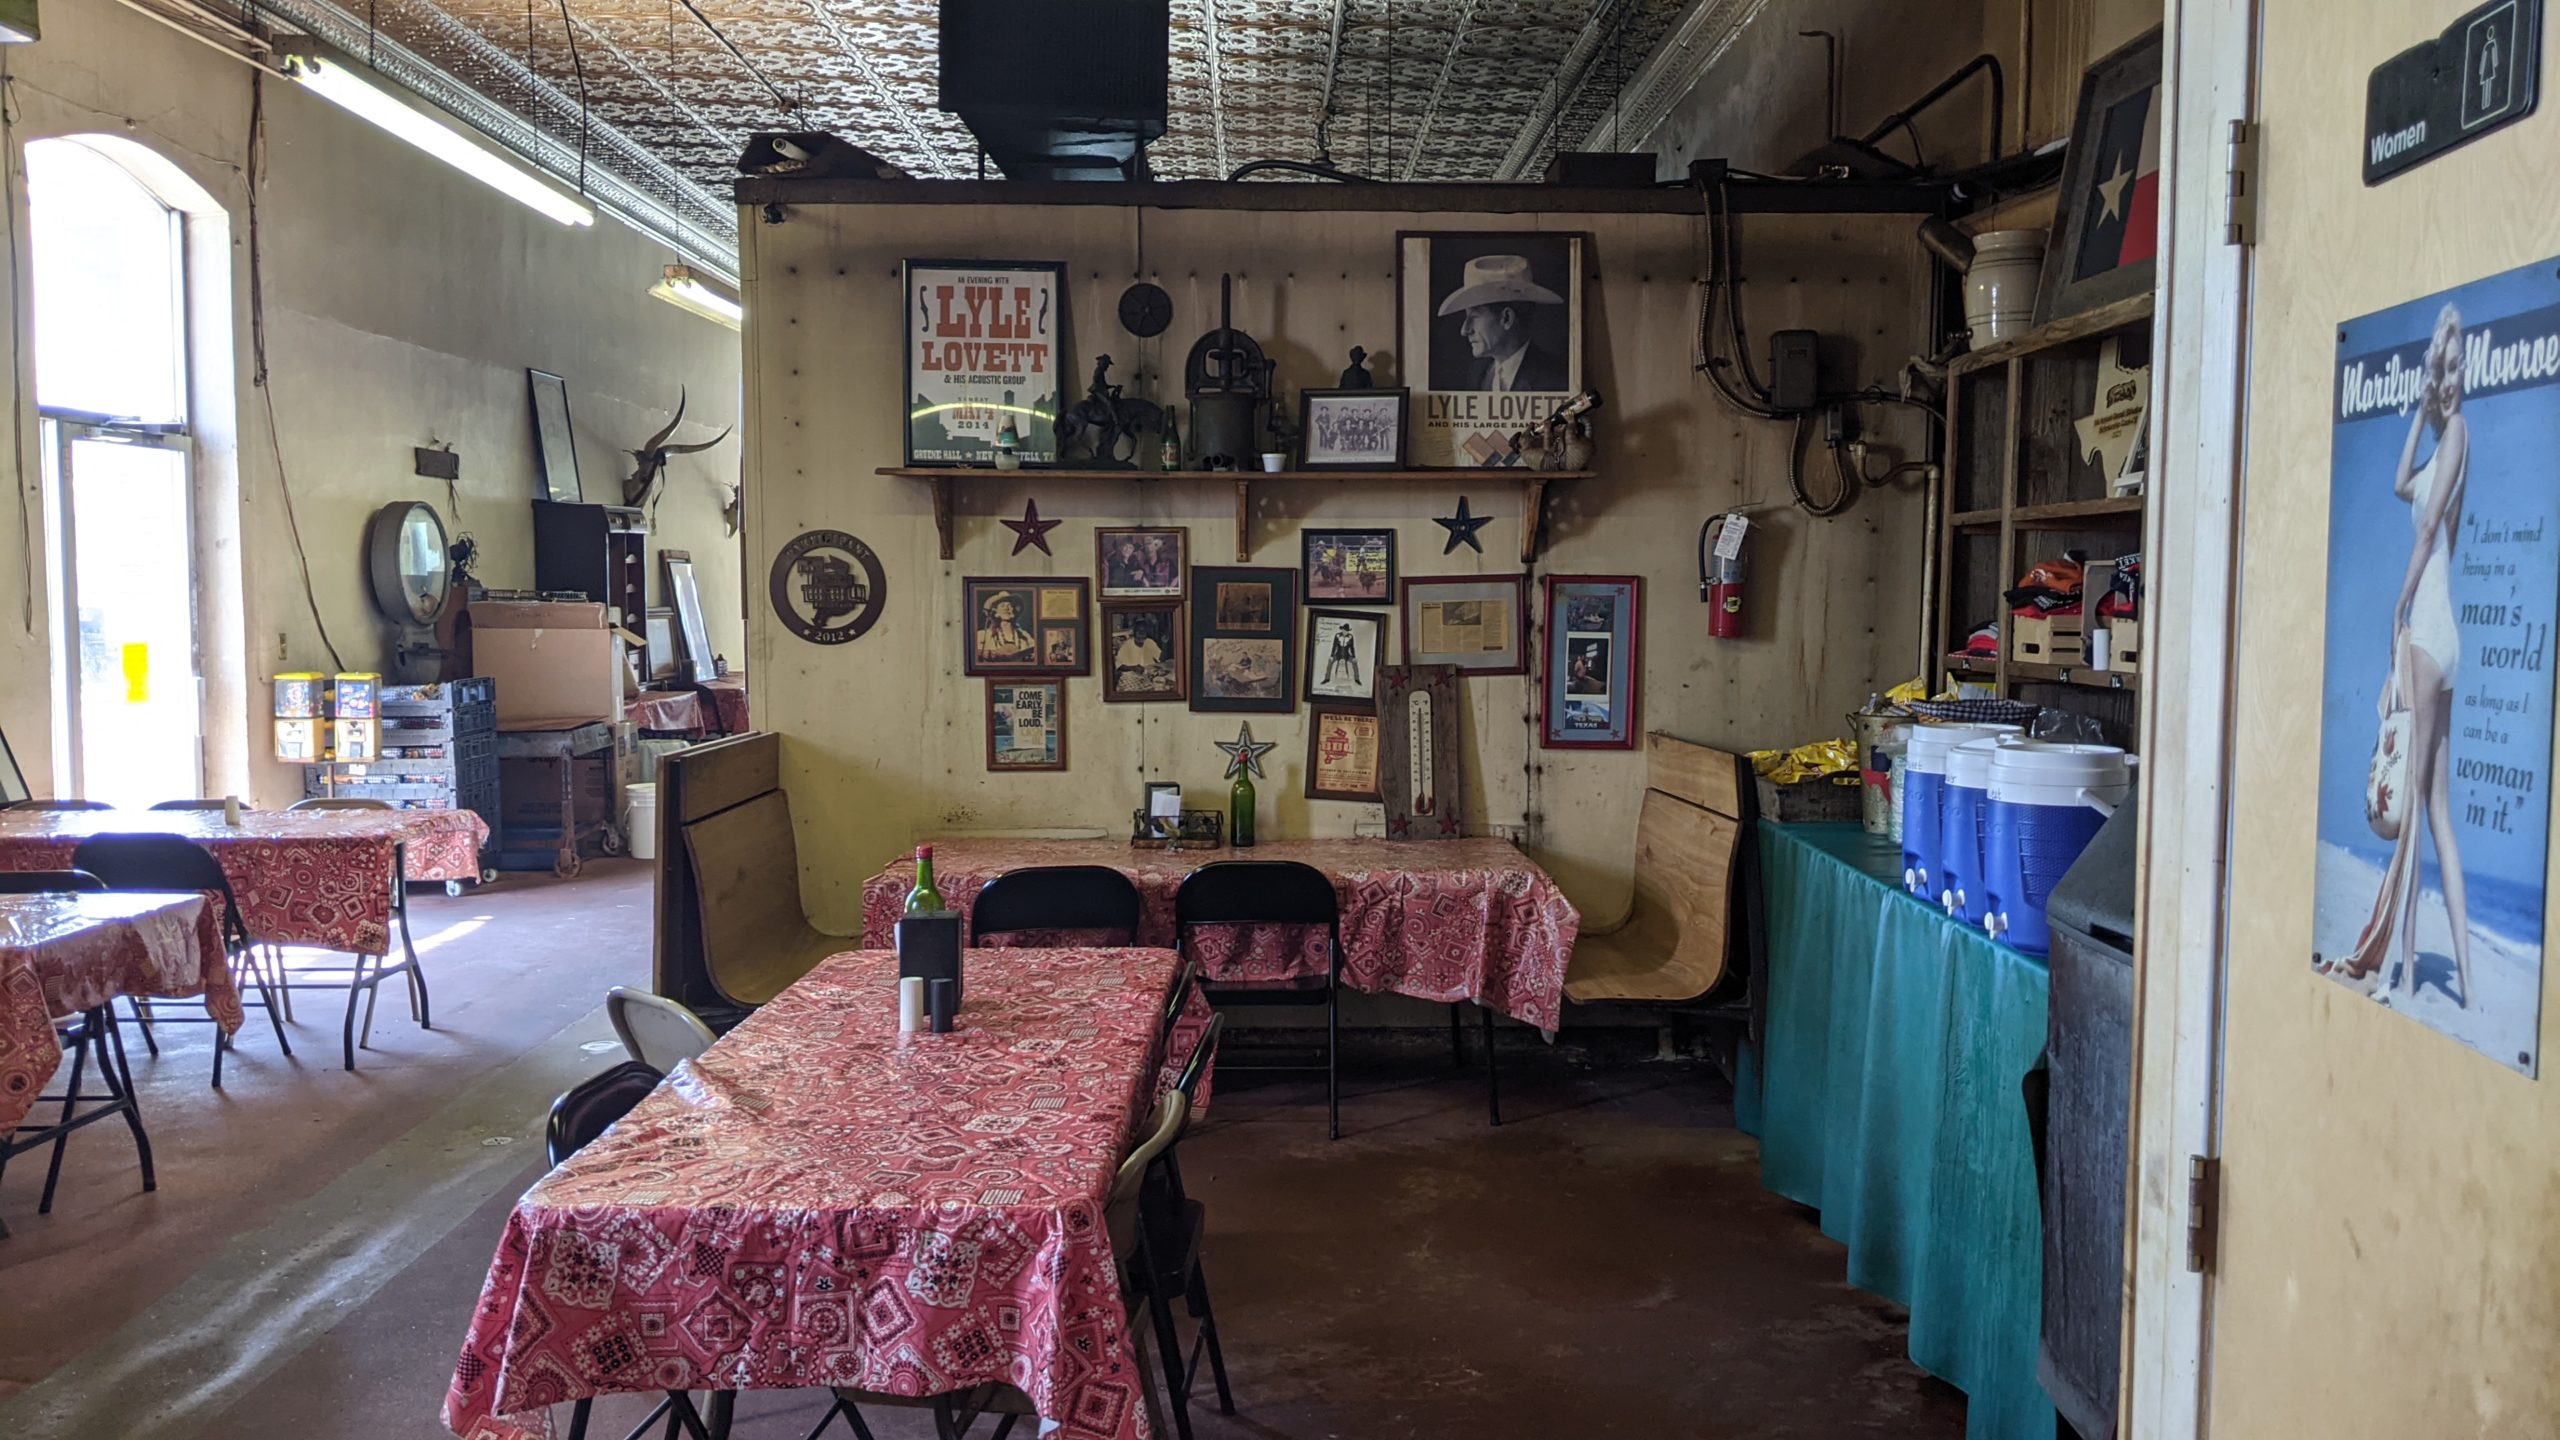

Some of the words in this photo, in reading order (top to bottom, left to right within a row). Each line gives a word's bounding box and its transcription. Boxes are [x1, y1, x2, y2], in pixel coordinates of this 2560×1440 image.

[2371, 120, 2426, 165] Women
[966, 276, 993, 285] EVENING
[994, 276, 1010, 285] WITH
[936, 286, 1031, 338] LYLE
[921, 340, 1048, 373] LOVETT
[943, 374, 952, 384] &
[953, 374, 967, 384] HIS
[968, 374, 1002, 385] ACOUSTIC
[1002, 375, 1026, 385] GROUP
[2341, 353, 2423, 418] Marilyn
[2463, 328, 2560, 395] Monroe
[1428, 394, 1479, 420] LYLE
[957, 421, 990, 430] 2014
[1427, 421, 1449, 429] AND
[1452, 421, 1470, 429] HIS
[1473, 421, 1507, 429] LARGE
[975, 450, 993, 461] NEW
[2480, 518, 2510, 544] don't
[2511, 516, 2544, 543] mind
[2494, 556, 2506, 577] in
[2506, 563, 2517, 577] a
[2460, 585, 2524, 628] man's
[814, 631, 845, 642] 2012
[2480, 621, 2547, 672] world
[1018, 691, 1043, 701] COME
[2464, 694, 2478, 707] as
[2479, 684, 2504, 716] long
[2505, 699, 2520, 713] as
[2520, 691, 2531, 714] I
[1018, 718, 1045, 728] LOUD.
[1032, 709, 1043, 719] BE
[2462, 725, 2482, 741] can
[2484, 717, 2499, 744] be
[2499, 731, 2509, 745] a
[2456, 757, 2534, 793] woman
[2465, 789, 2486, 828] in
